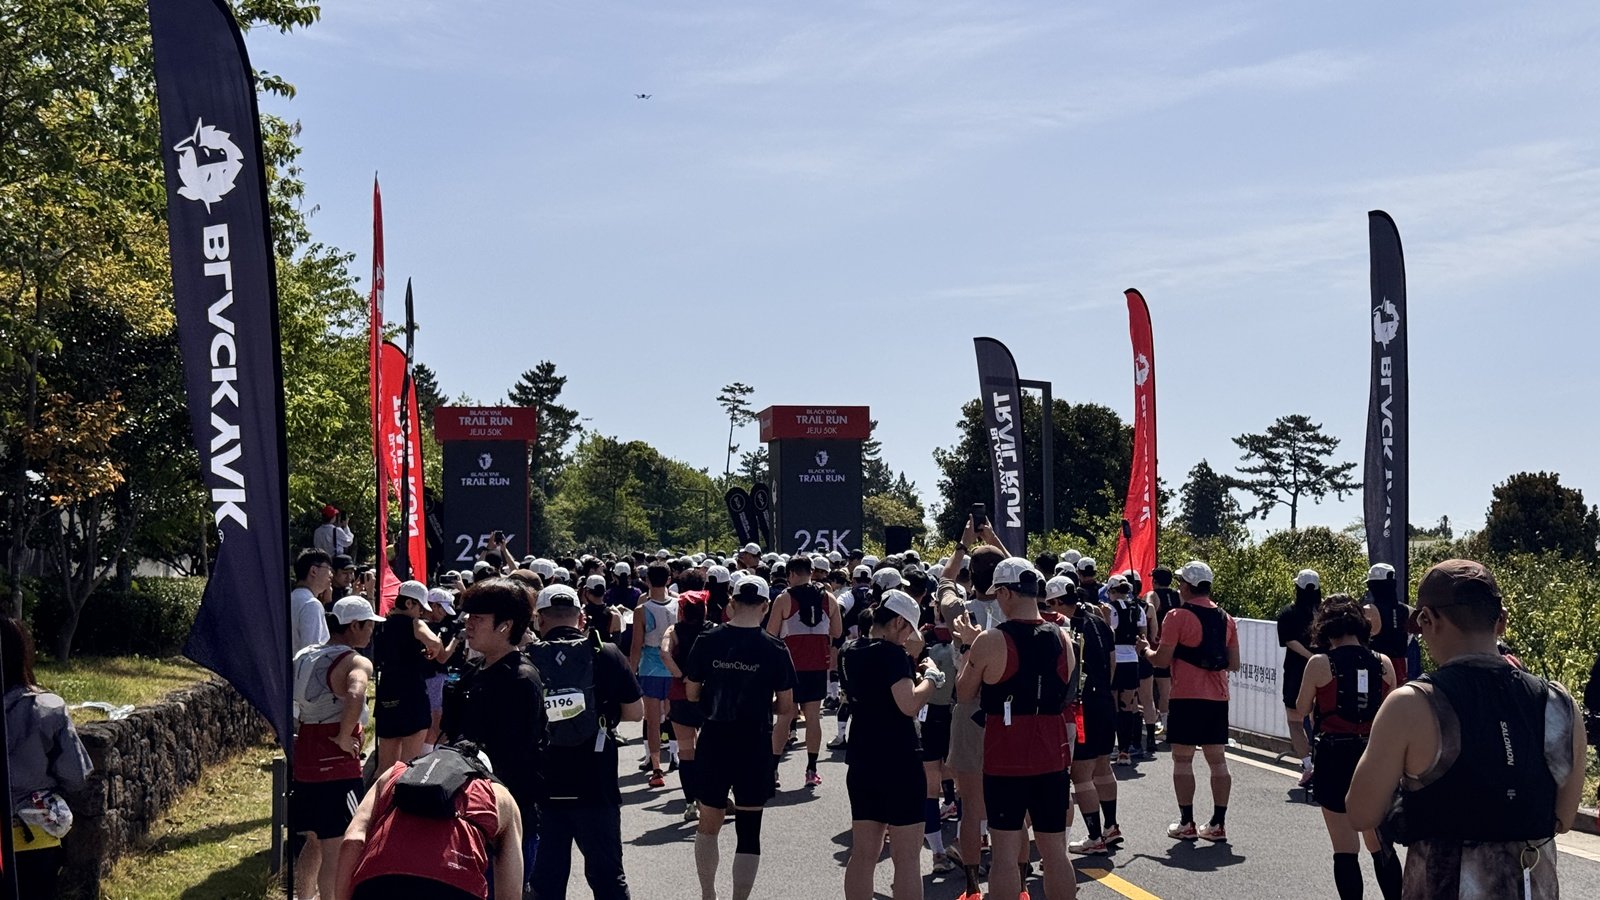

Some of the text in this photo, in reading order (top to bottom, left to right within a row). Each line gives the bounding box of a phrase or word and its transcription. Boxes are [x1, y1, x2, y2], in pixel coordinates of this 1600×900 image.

[458, 416, 513, 426] TRAIL RUN
[796, 415, 848, 424] TRAIL RUN
[469, 428, 502, 436] JEJU 50K
[461, 478, 510, 486] TRAIL RUN
[799, 474, 846, 482] TRAIL RUN
[794, 529, 851, 557] 25K
[544, 697, 574, 710] 3196
[1500, 720, 1515, 766] SALOMON
